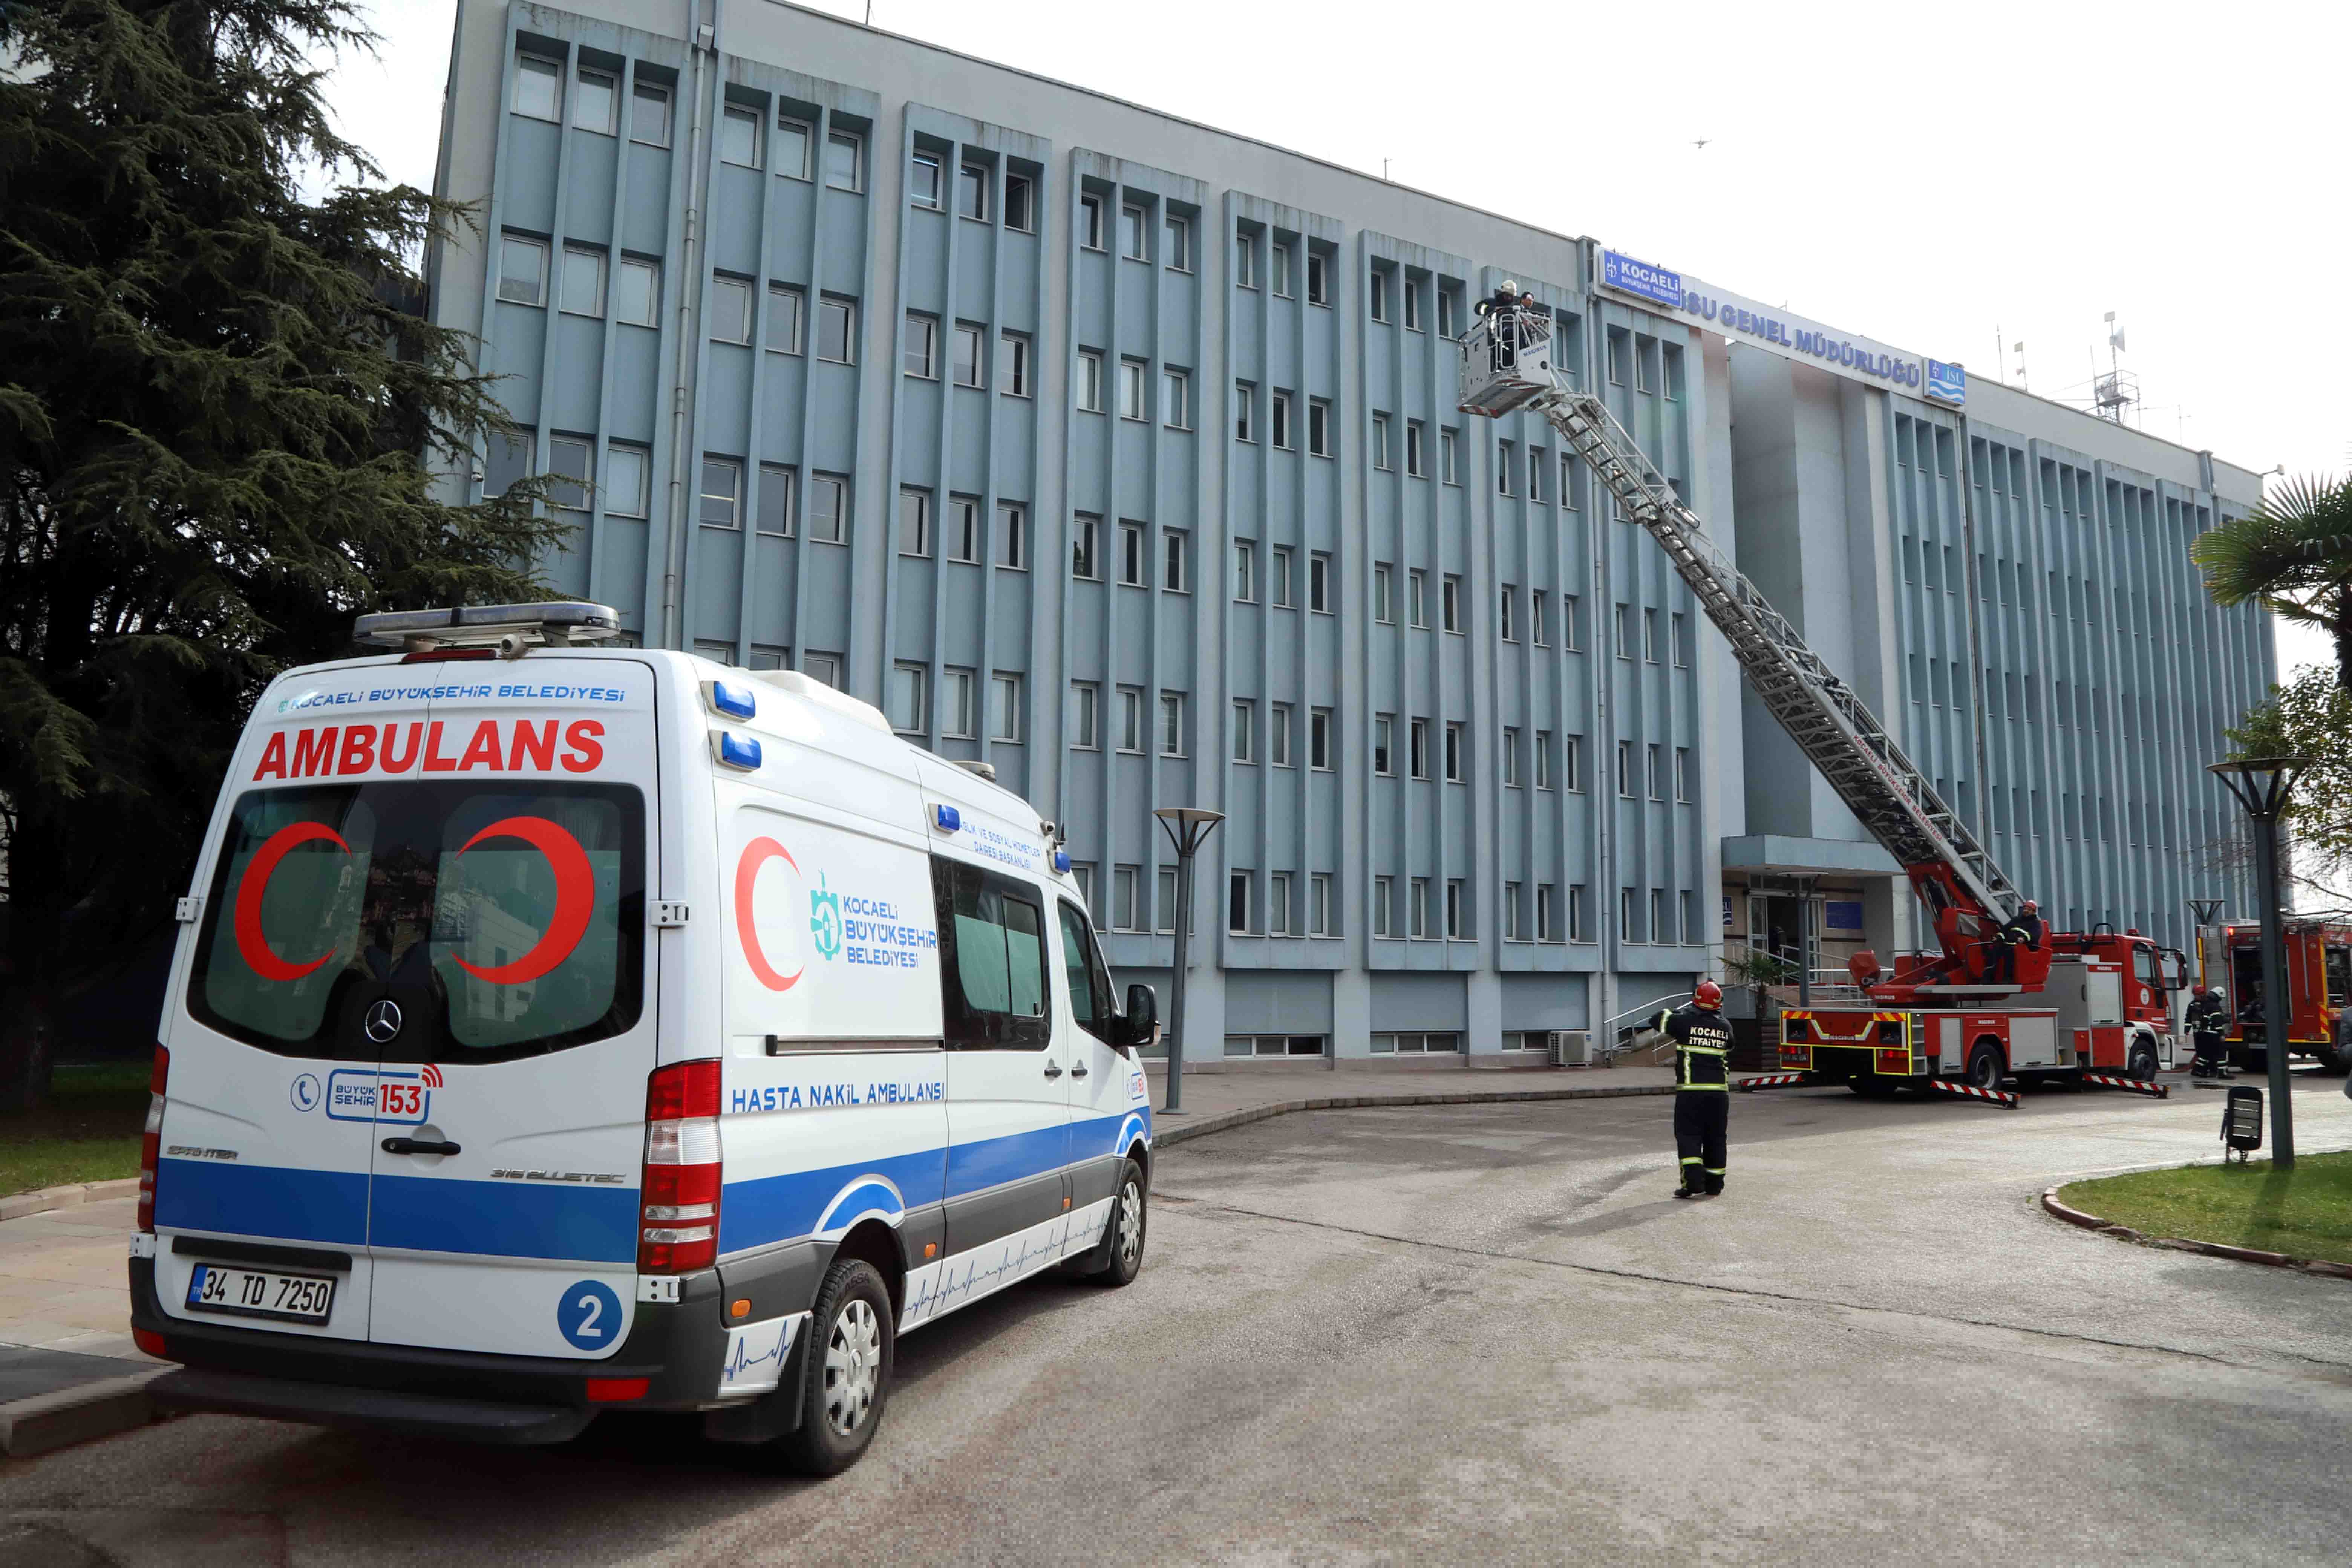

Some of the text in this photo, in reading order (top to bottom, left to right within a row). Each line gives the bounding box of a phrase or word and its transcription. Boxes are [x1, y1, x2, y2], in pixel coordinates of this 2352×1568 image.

[1621, 262, 1678, 292] KOCAELİ
[1720, 304, 1791, 347] GENEL
[1795, 329, 1920, 388] MÜDÜRLÜĞÜ
[1947, 366, 1963, 383] İSU
[290, 685, 625, 709] KOCAELİ BÜYÜKŞEHİR BELEDİYESİ
[252, 719, 605, 781] AMBULANS
[842, 896, 899, 920] KOCAELİ
[845, 920, 937, 950] BÜYÜKŞEHİR
[847, 946, 919, 968] BELEDİYESİ
[1690, 1026, 1728, 1040] KOCAELİ
[335, 1085, 375, 1096] BÜYÜK
[335, 1094, 375, 1107] ŞEHİR
[380, 1083, 421, 1115] 153
[732, 1081, 945, 1113] HASTA NAKİL AMBULANSI
[167, 1145, 239, 1160] SPRINTER
[526, 1169, 627, 1184] BLUETEC
[192, 1286, 201, 1294] TR
[202, 1270, 329, 1313] 34 TD 7250
[576, 1295, 602, 1337] 2
